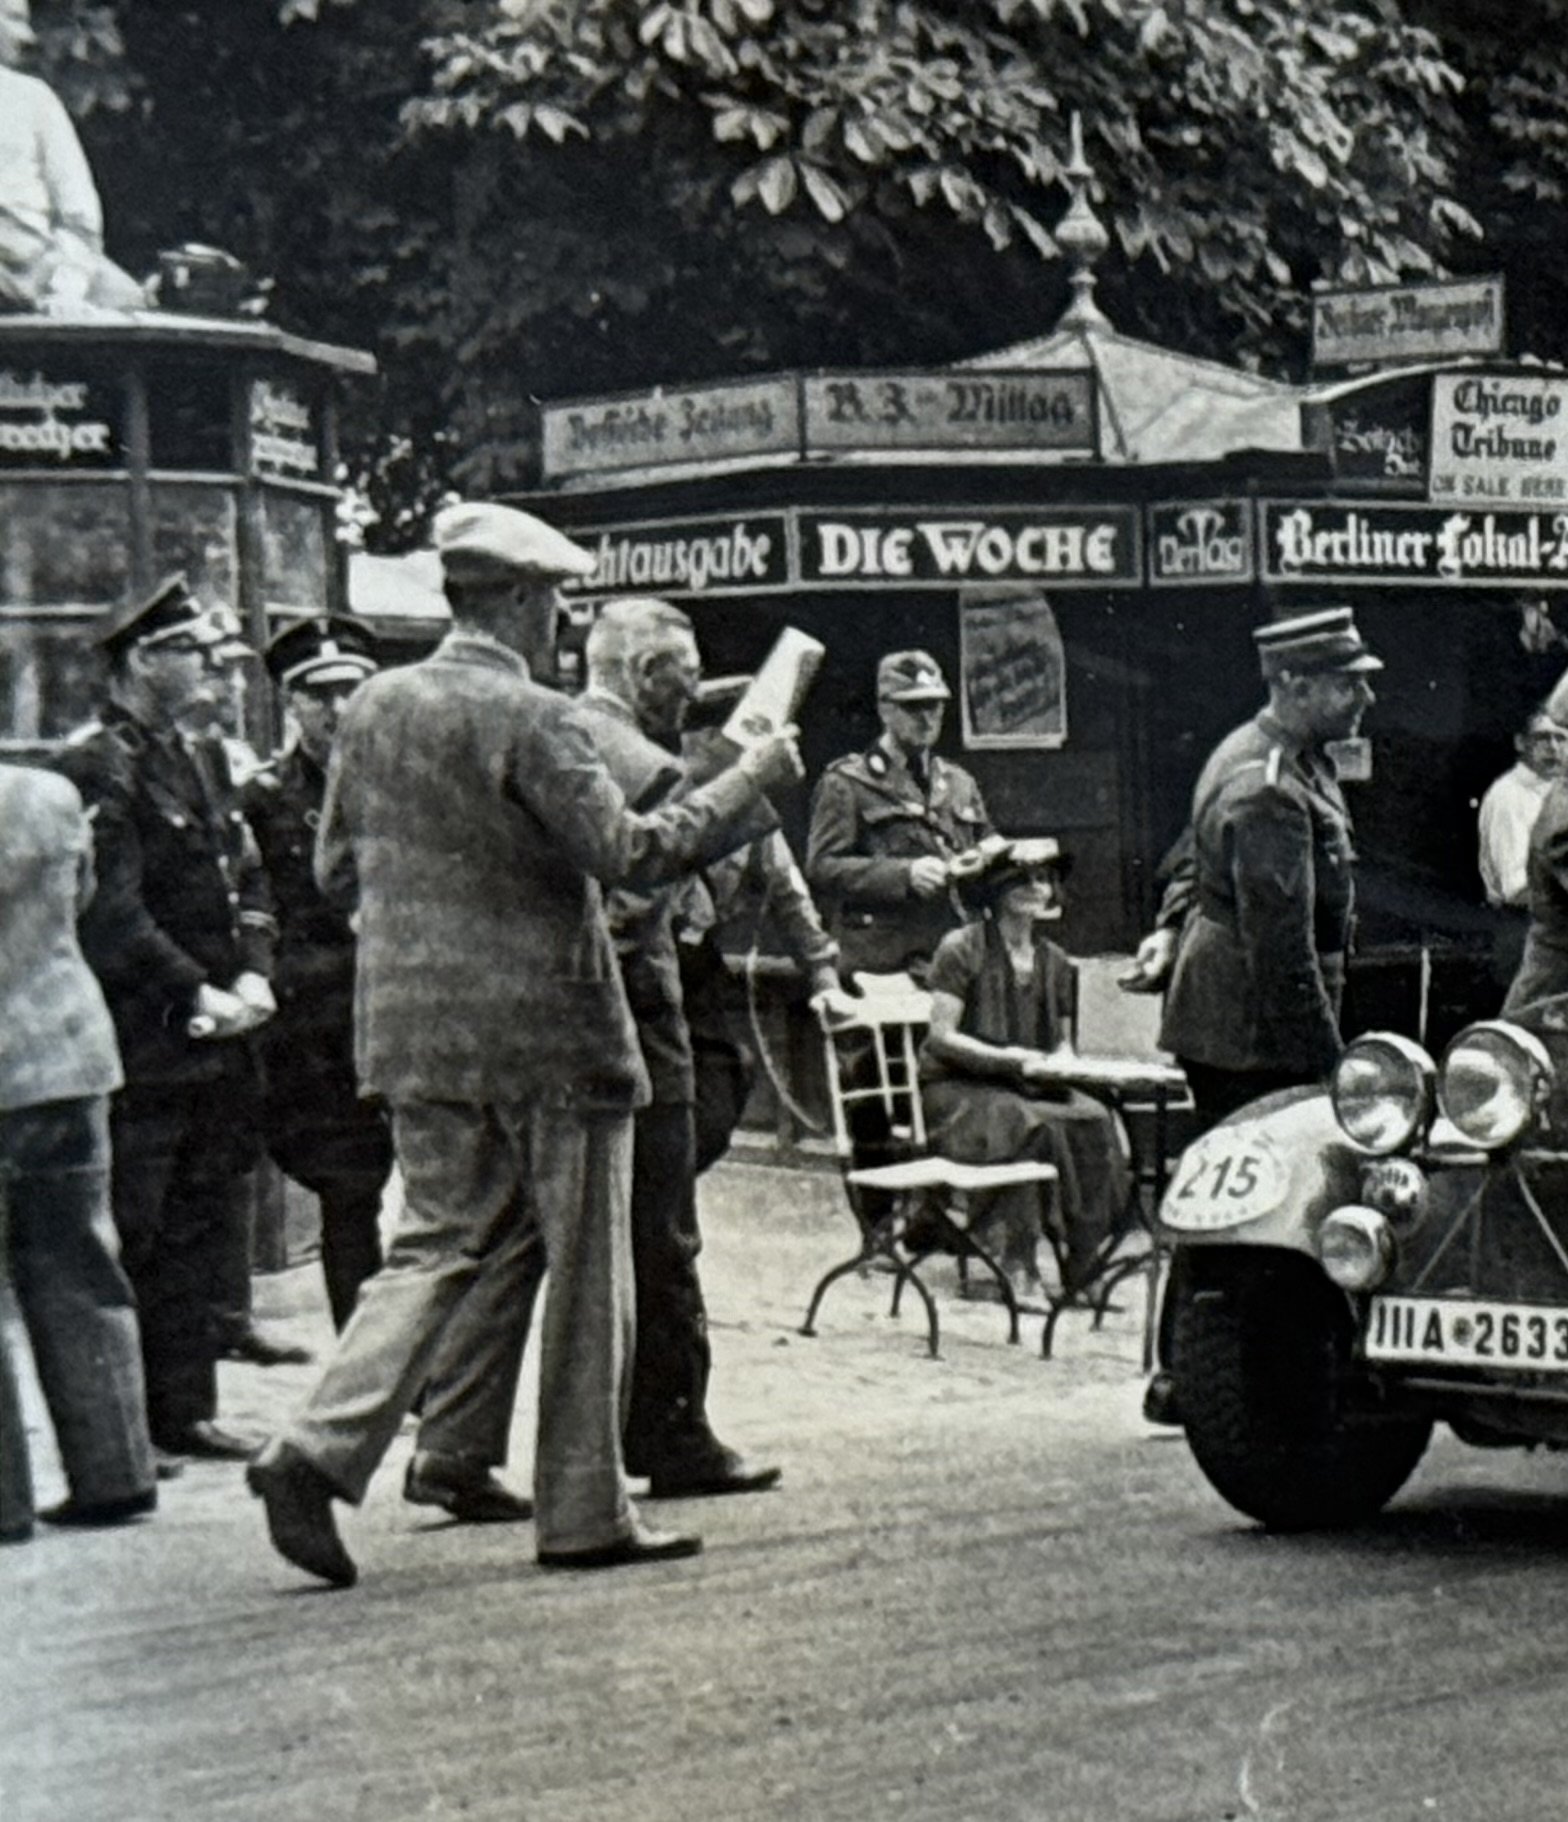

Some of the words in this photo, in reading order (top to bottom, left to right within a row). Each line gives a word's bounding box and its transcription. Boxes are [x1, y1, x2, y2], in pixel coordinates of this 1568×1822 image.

[1454, 380, 1561, 425] Chicago
[1452, 422, 1557, 462] Tribune
[1463, 475, 1509, 496] SALE
[562, 523, 771, 592] htausgabe
[818, 524, 913, 575] DIE
[917, 522, 1117, 575] WOCHE
[1276, 509, 1432, 576] Berliner
[1177, 1155, 1261, 1200] 215
